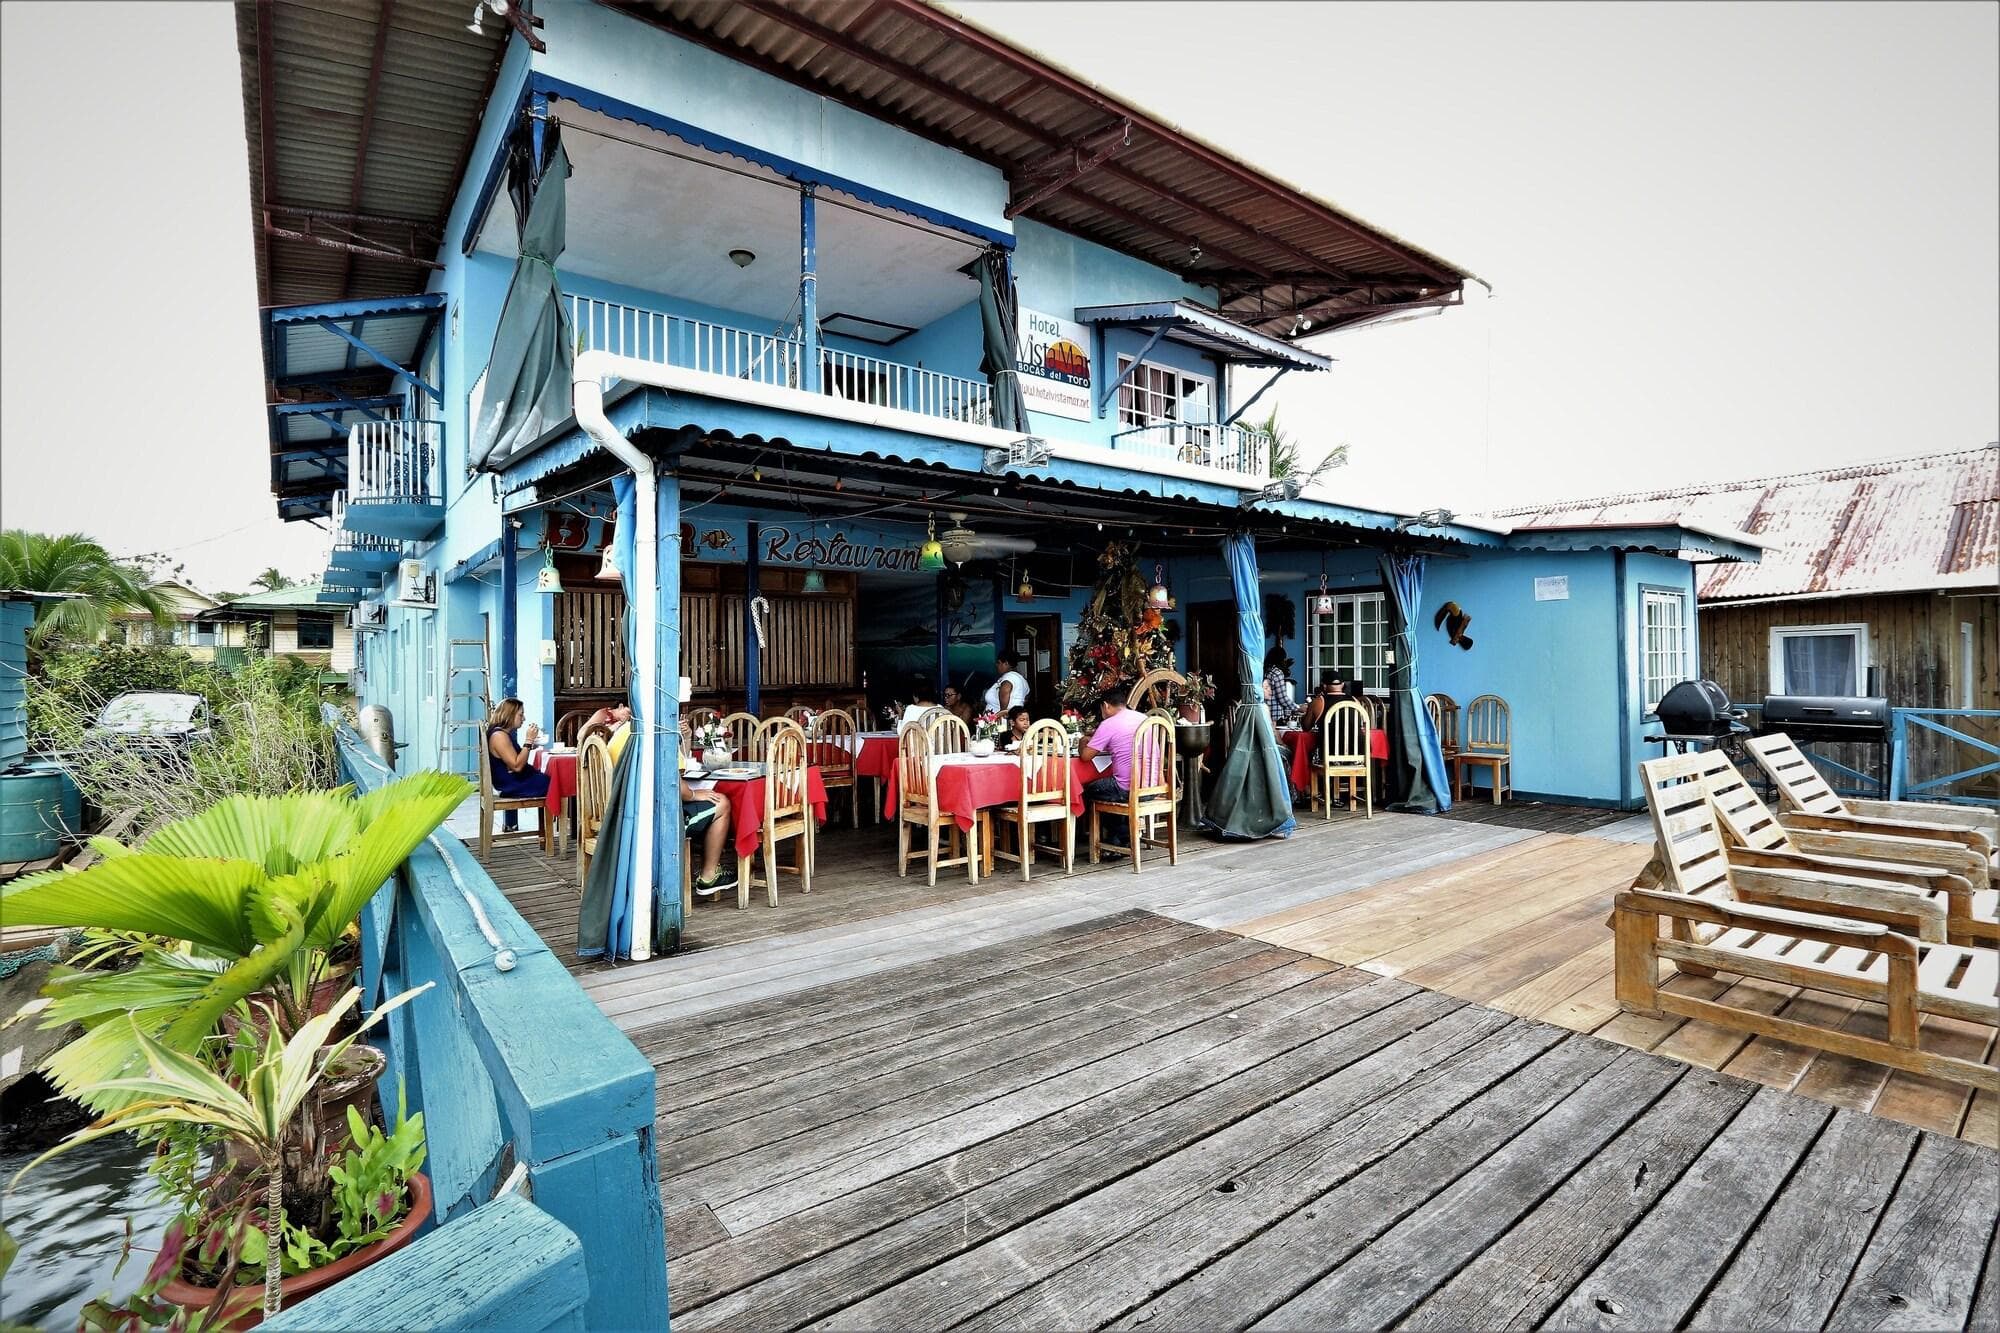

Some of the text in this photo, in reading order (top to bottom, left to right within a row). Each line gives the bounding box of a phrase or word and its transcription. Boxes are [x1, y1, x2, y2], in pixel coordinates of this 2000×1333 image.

[1029, 314, 1061, 337] Hotel
[1018, 363, 1046, 376] BOCAS
[1049, 371, 1062, 379] del
